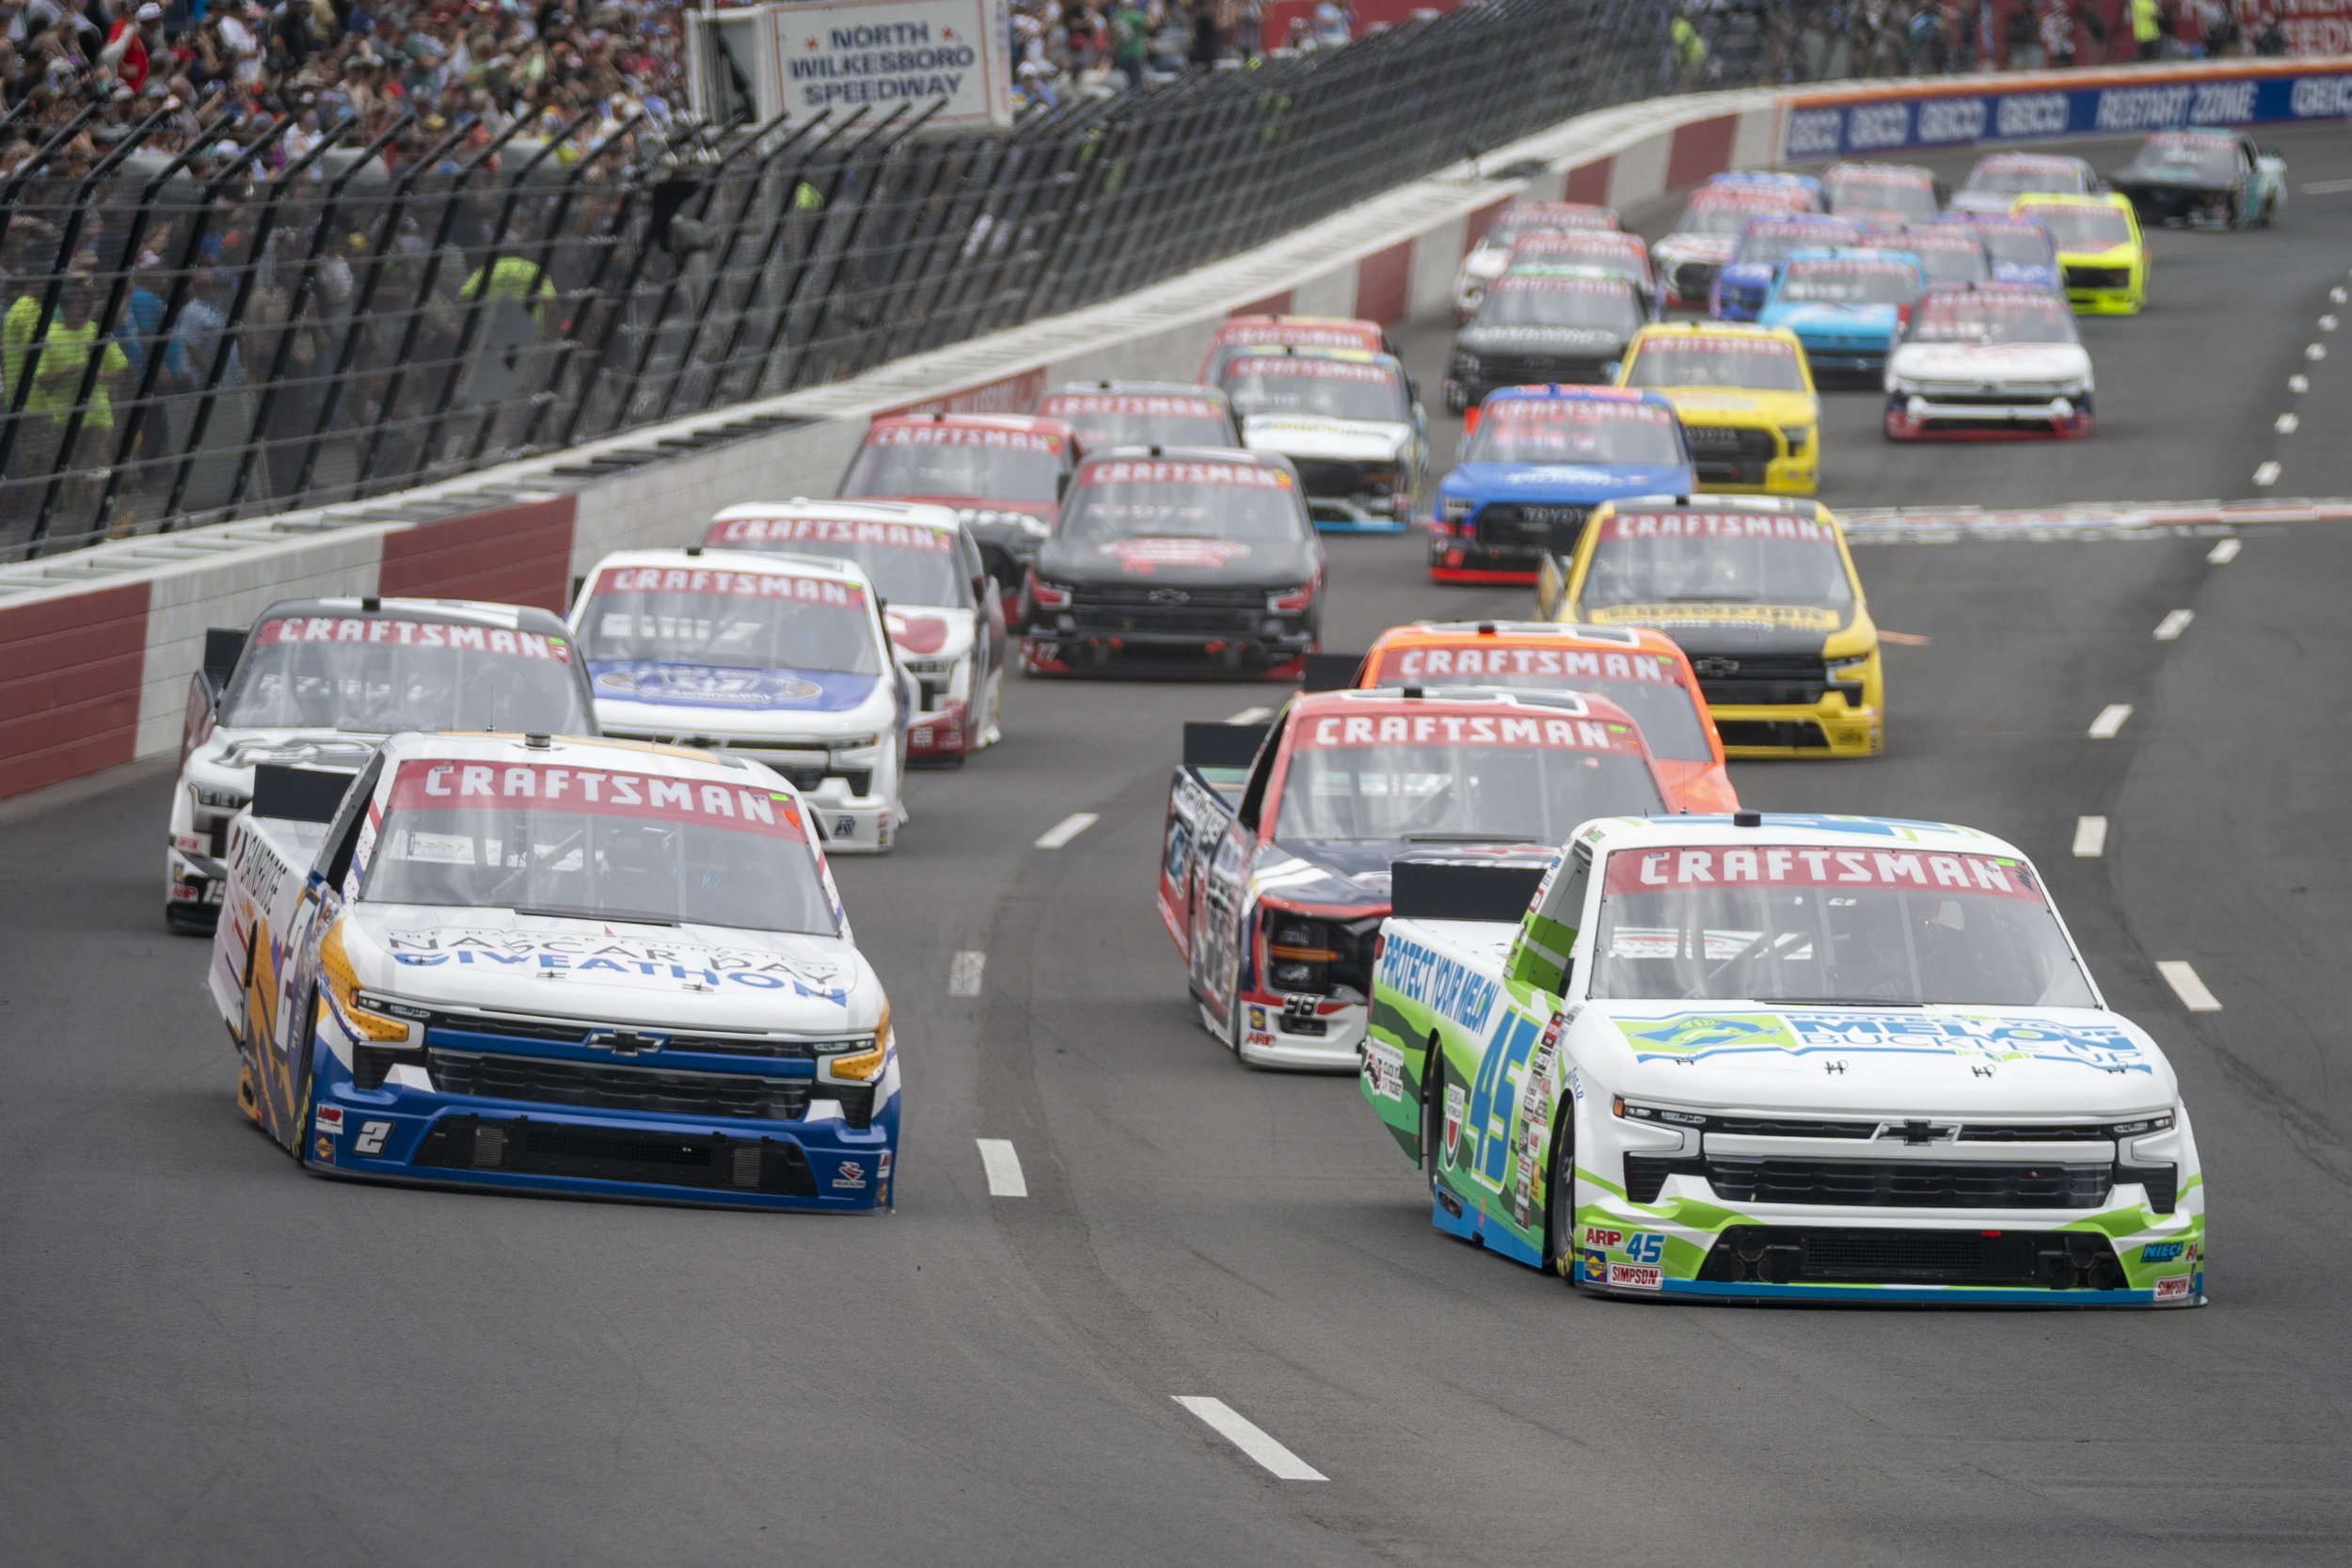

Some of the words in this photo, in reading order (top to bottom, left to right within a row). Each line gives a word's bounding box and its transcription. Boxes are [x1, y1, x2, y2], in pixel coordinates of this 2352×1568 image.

[832, 23, 930, 47] NORTH
[791, 45, 975, 79] WILKESBORO
[803, 73, 962, 106] SPEEDWAY
[2095, 85, 2193, 129] RESTART
[2187, 80, 2257, 123] ZONE
[1996, 92, 2069, 135] GEICO
[1226, 326, 1363, 348] CRAFTSMAN
[1238, 357, 1386, 383] CRAFTSMAN
[1050, 397, 1209, 418] CRAFTSMAN
[1494, 400, 1654, 422] CRAFTSMAN
[877, 426, 1051, 453] CRAFTSMAN
[1092, 465, 1279, 488] CRAFTSMAN
[724, 519, 935, 547] CRAFTSMAN
[1615, 515, 1823, 541] CRAFTSMAN
[613, 569, 846, 604] CRAFTSMAN
[278, 617, 551, 658] CRAFTSMAN
[1401, 649, 1662, 680] CRAFTSMAN
[1316, 716, 1610, 748] CRAFTSMAN
[426, 765, 775, 825] CRAFTSMAN
[1640, 850, 2013, 892] CRAFTSMAN
[389, 936, 679, 962] NASCAR
[709, 956, 837, 986] DAY
[1379, 932, 1438, 1004] PROTECT
[1429, 956, 1465, 1020] YOUR
[1453, 969, 1502, 1036] MELON
[1791, 1021, 2137, 1052] MELON
[1802, 1034, 2043, 1053] BUCKLE
[2063, 1045, 2142, 1063] UP
[1467, 1006, 1543, 1195] 45
[355, 1119, 394, 1156] 2
[1585, 1227, 1623, 1247] ARP
[1626, 1233, 1666, 1264] 45
[1612, 1265, 1659, 1286] SIMPSON
